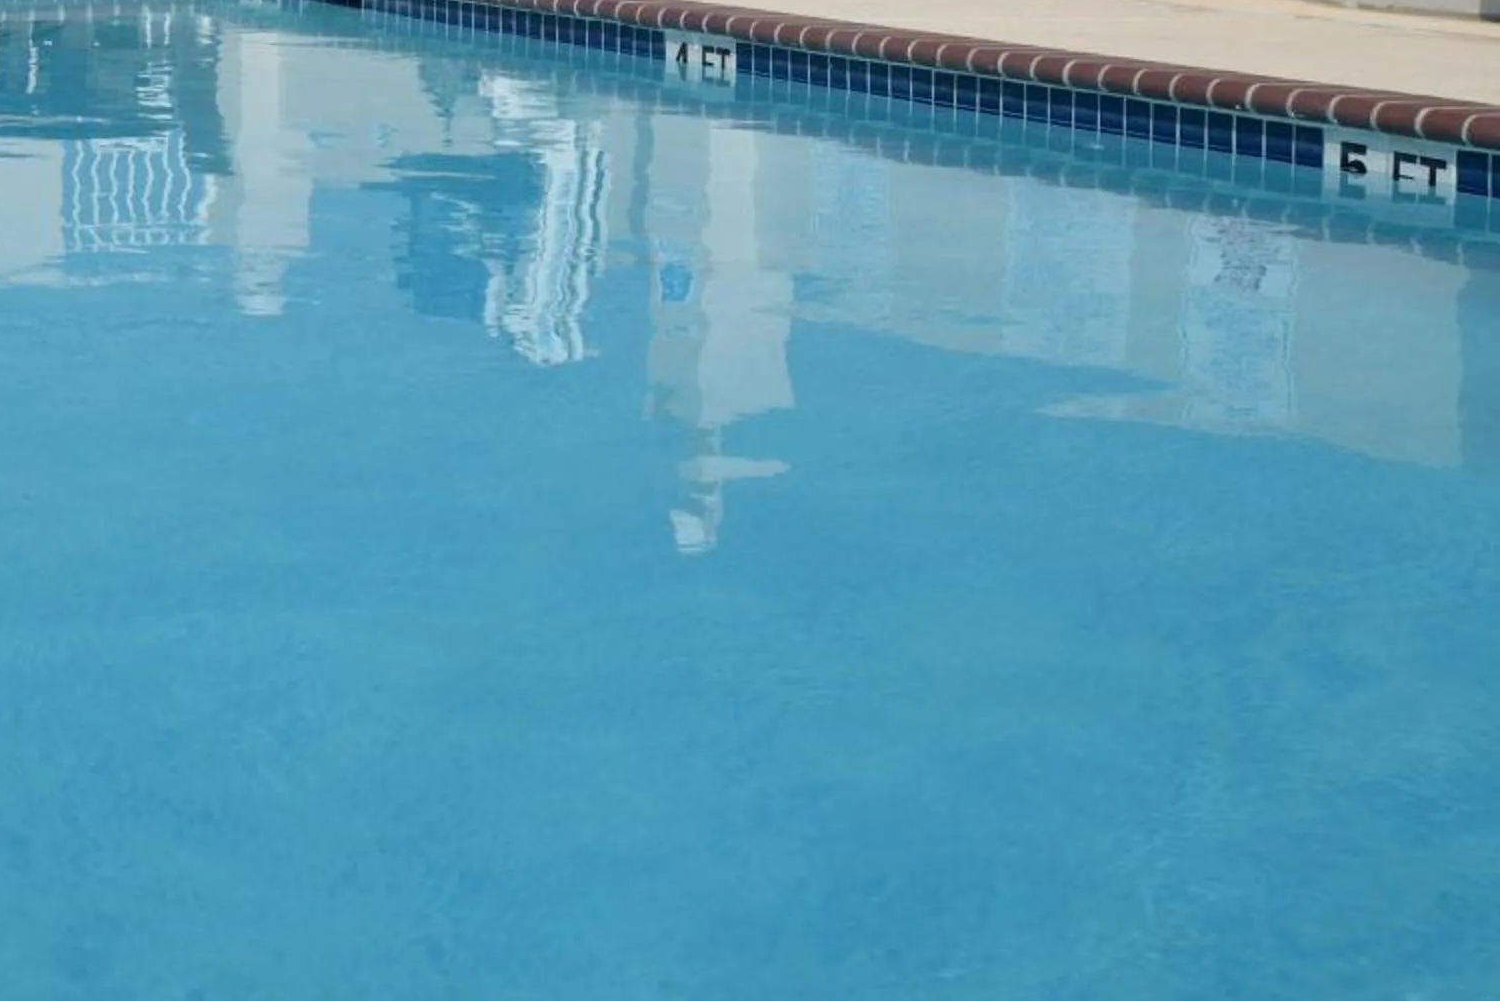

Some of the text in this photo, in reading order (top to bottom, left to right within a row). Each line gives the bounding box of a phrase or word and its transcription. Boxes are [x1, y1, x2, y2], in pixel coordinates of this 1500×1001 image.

[702, 46, 731, 71] FT
[1340, 141, 1447, 187] 5 FT
